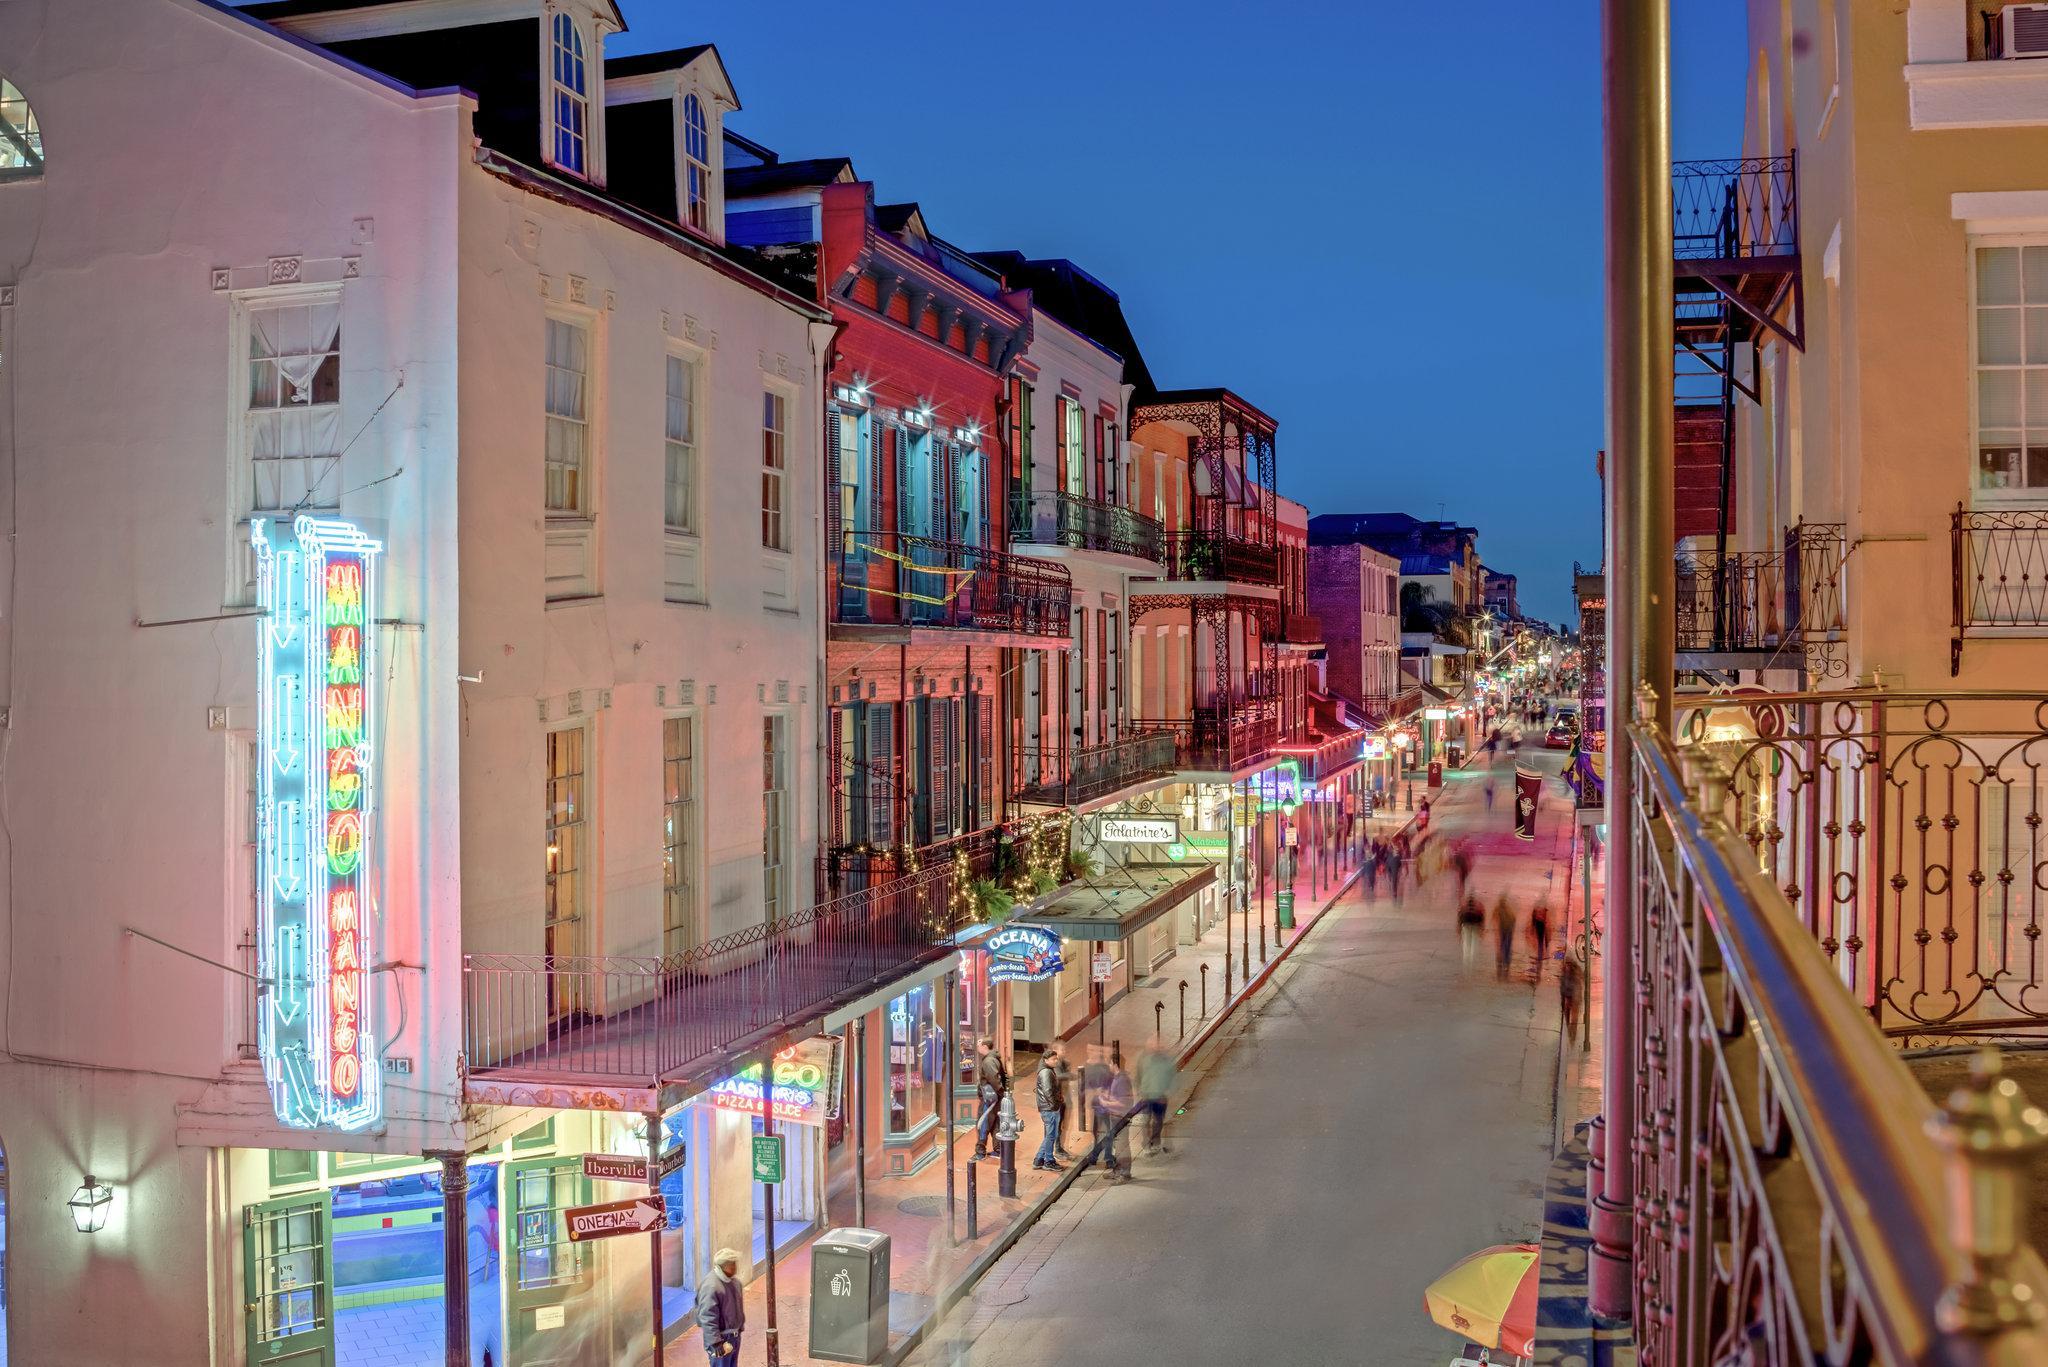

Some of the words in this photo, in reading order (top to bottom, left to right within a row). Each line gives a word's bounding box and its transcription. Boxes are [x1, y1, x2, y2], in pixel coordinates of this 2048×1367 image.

[324, 562, 363, 877] MANGO
[1104, 822, 1172, 839] Galatoire's
[1169, 845, 1185, 857] 33
[989, 930, 1048, 951] OCEANA
[328, 889, 360, 1097] MANGO
[716, 1094, 754, 1109] PIZZA
[772, 1102, 802, 1118] SLICE
[587, 1161, 645, 1177] Iberville
[577, 1215, 602, 1231] ONE
